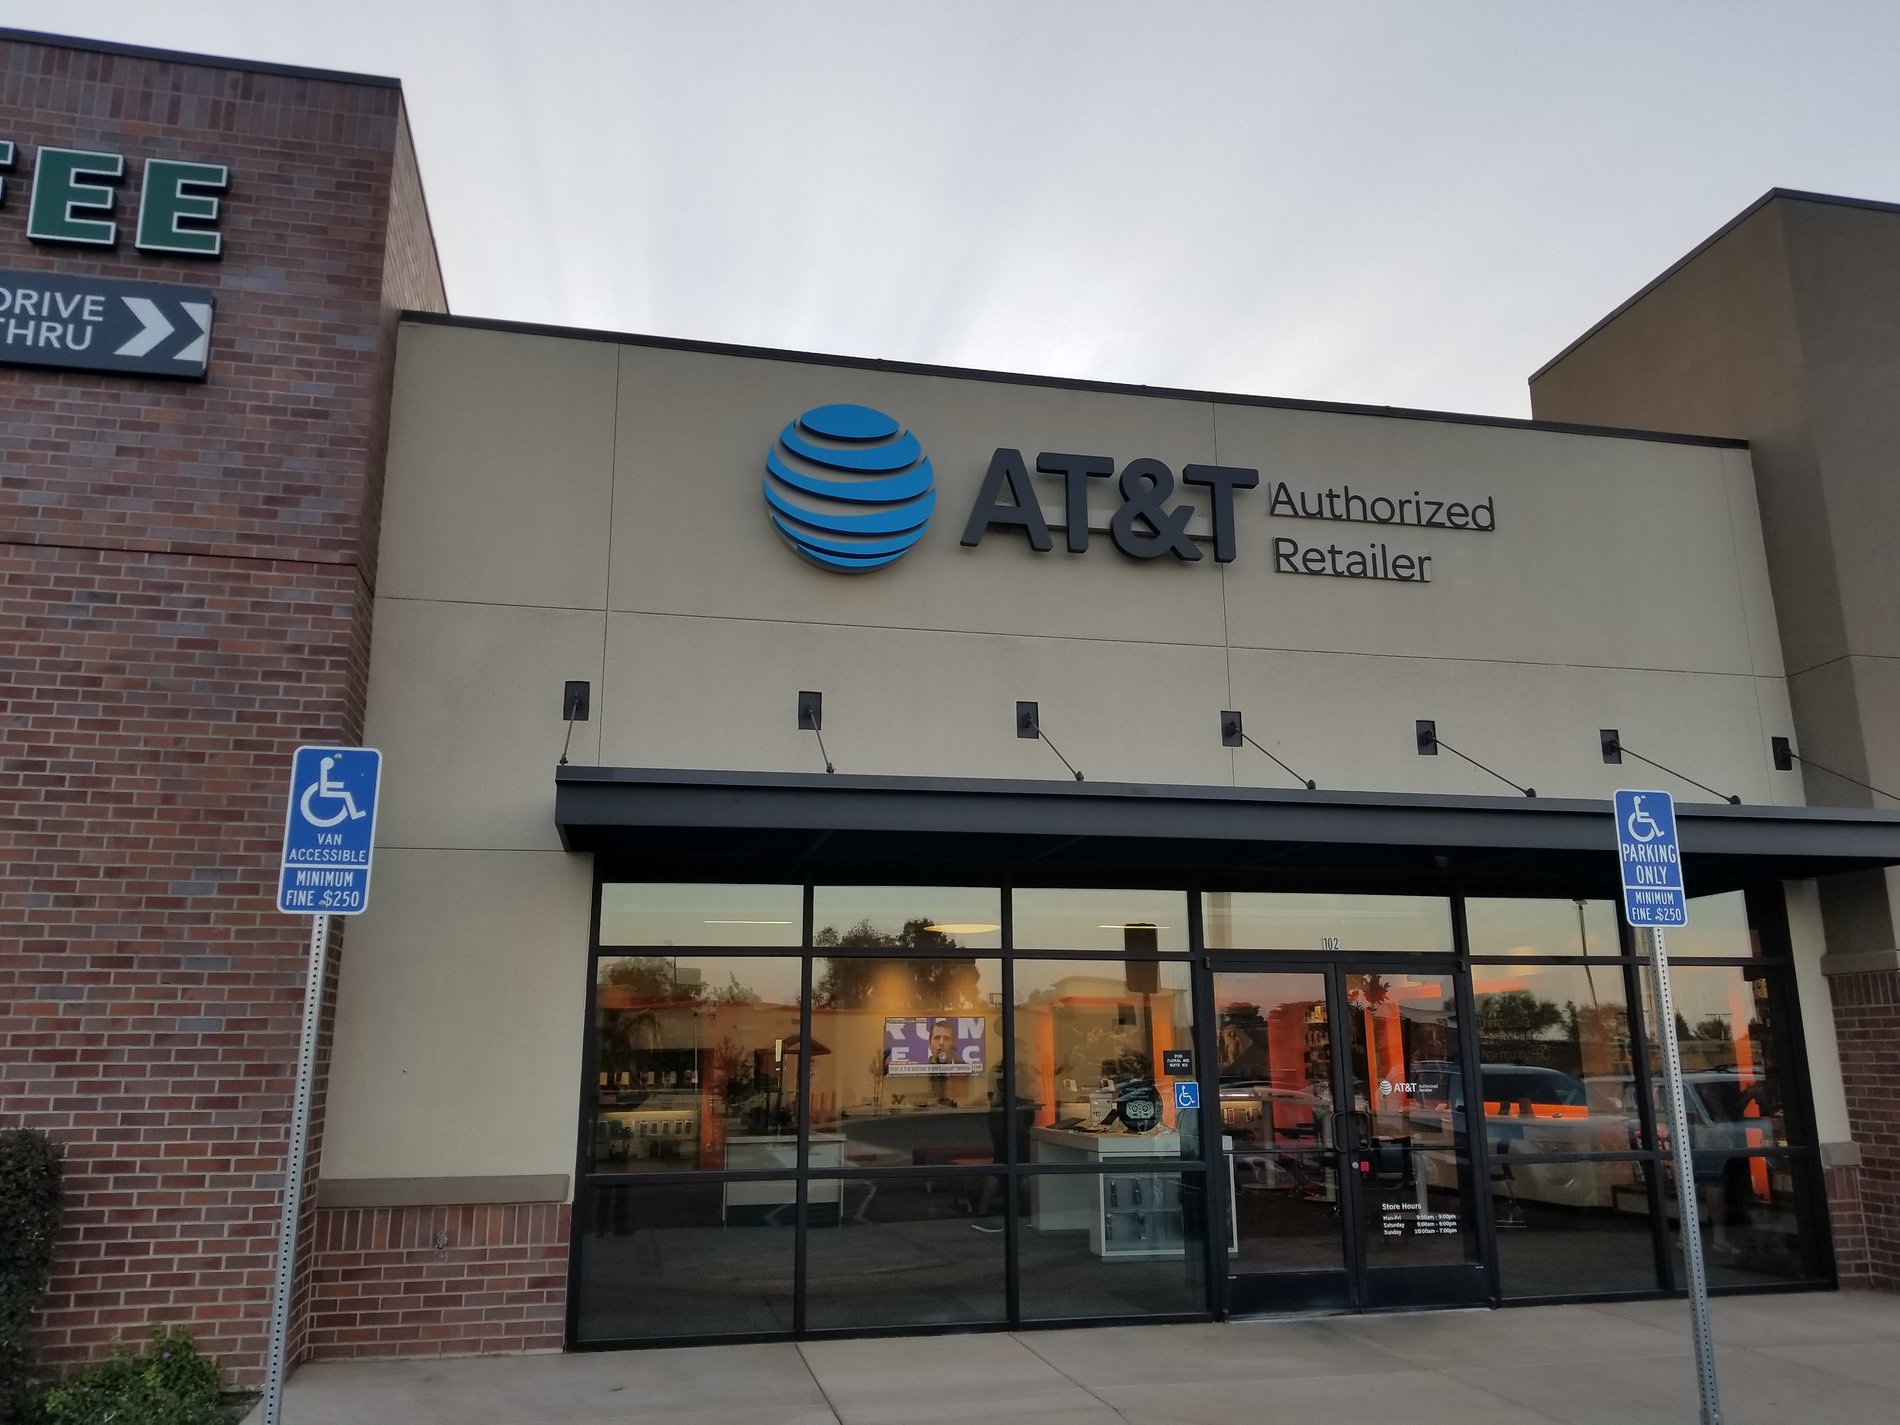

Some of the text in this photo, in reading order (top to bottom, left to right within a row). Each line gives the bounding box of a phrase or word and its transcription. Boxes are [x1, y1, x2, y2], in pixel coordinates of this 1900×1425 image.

[0, 140, 230, 258] EE
[0, 317, 93, 350] HRU
[959, 447, 1260, 564] AT&T
[1270, 481, 1496, 532] Authorized
[1273, 536, 1432, 583] Retailer
[317, 833, 342, 846] VAN
[289, 848, 366, 862] ACCESSIBLE
[1622, 843, 1677, 863] PARKING
[296, 870, 353, 887] MINIMUM
[1636, 865, 1667, 884] ONLY
[285, 889, 360, 908] FINE $250
[1635, 891, 1675, 905] MINIMUM
[1632, 907, 1682, 922] FINE $250
[1323, 937, 1339, 950] 102
[1394, 1082, 1417, 1093] AT&T
[1401, 1202, 1422, 1210] Hours
